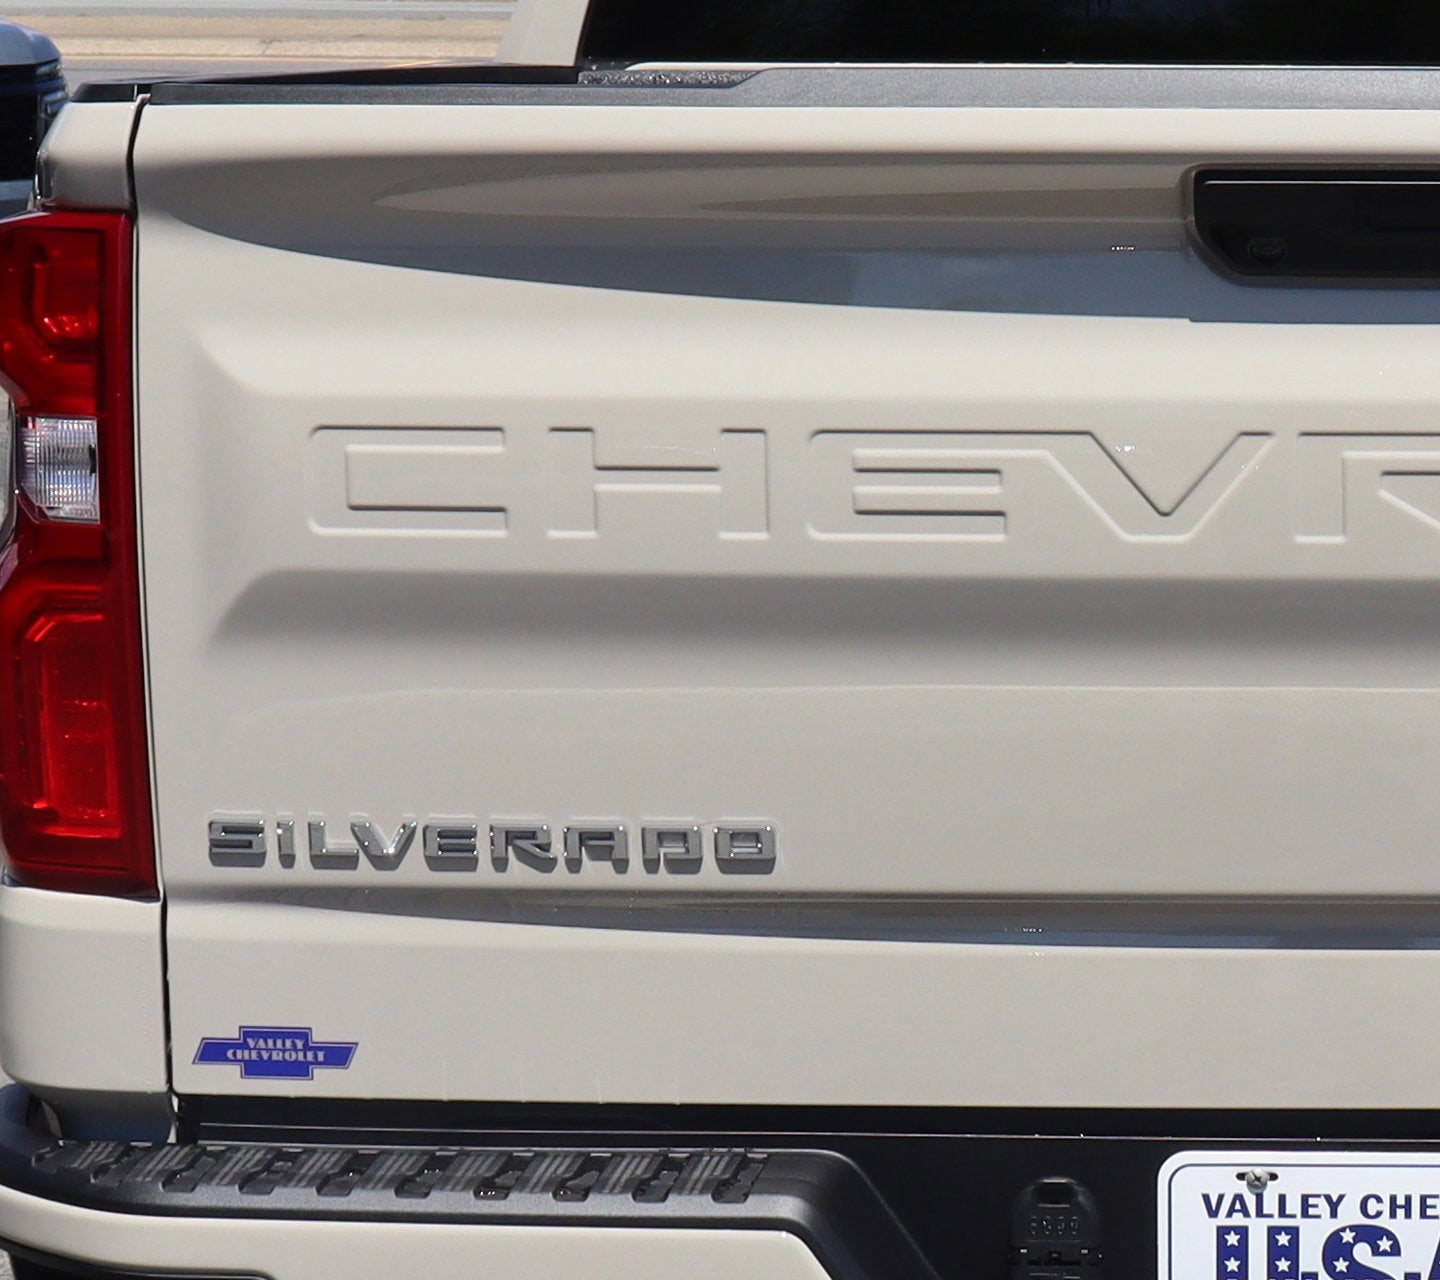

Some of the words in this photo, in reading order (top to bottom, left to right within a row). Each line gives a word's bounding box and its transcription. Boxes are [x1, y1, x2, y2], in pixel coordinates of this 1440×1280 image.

[208, 820, 776, 874] SILVERADO
[246, 1037, 305, 1050] VALLEY
[226, 1049, 326, 1062] CHEVROLET
[1201, 1193, 1347, 1219] VALLEY
